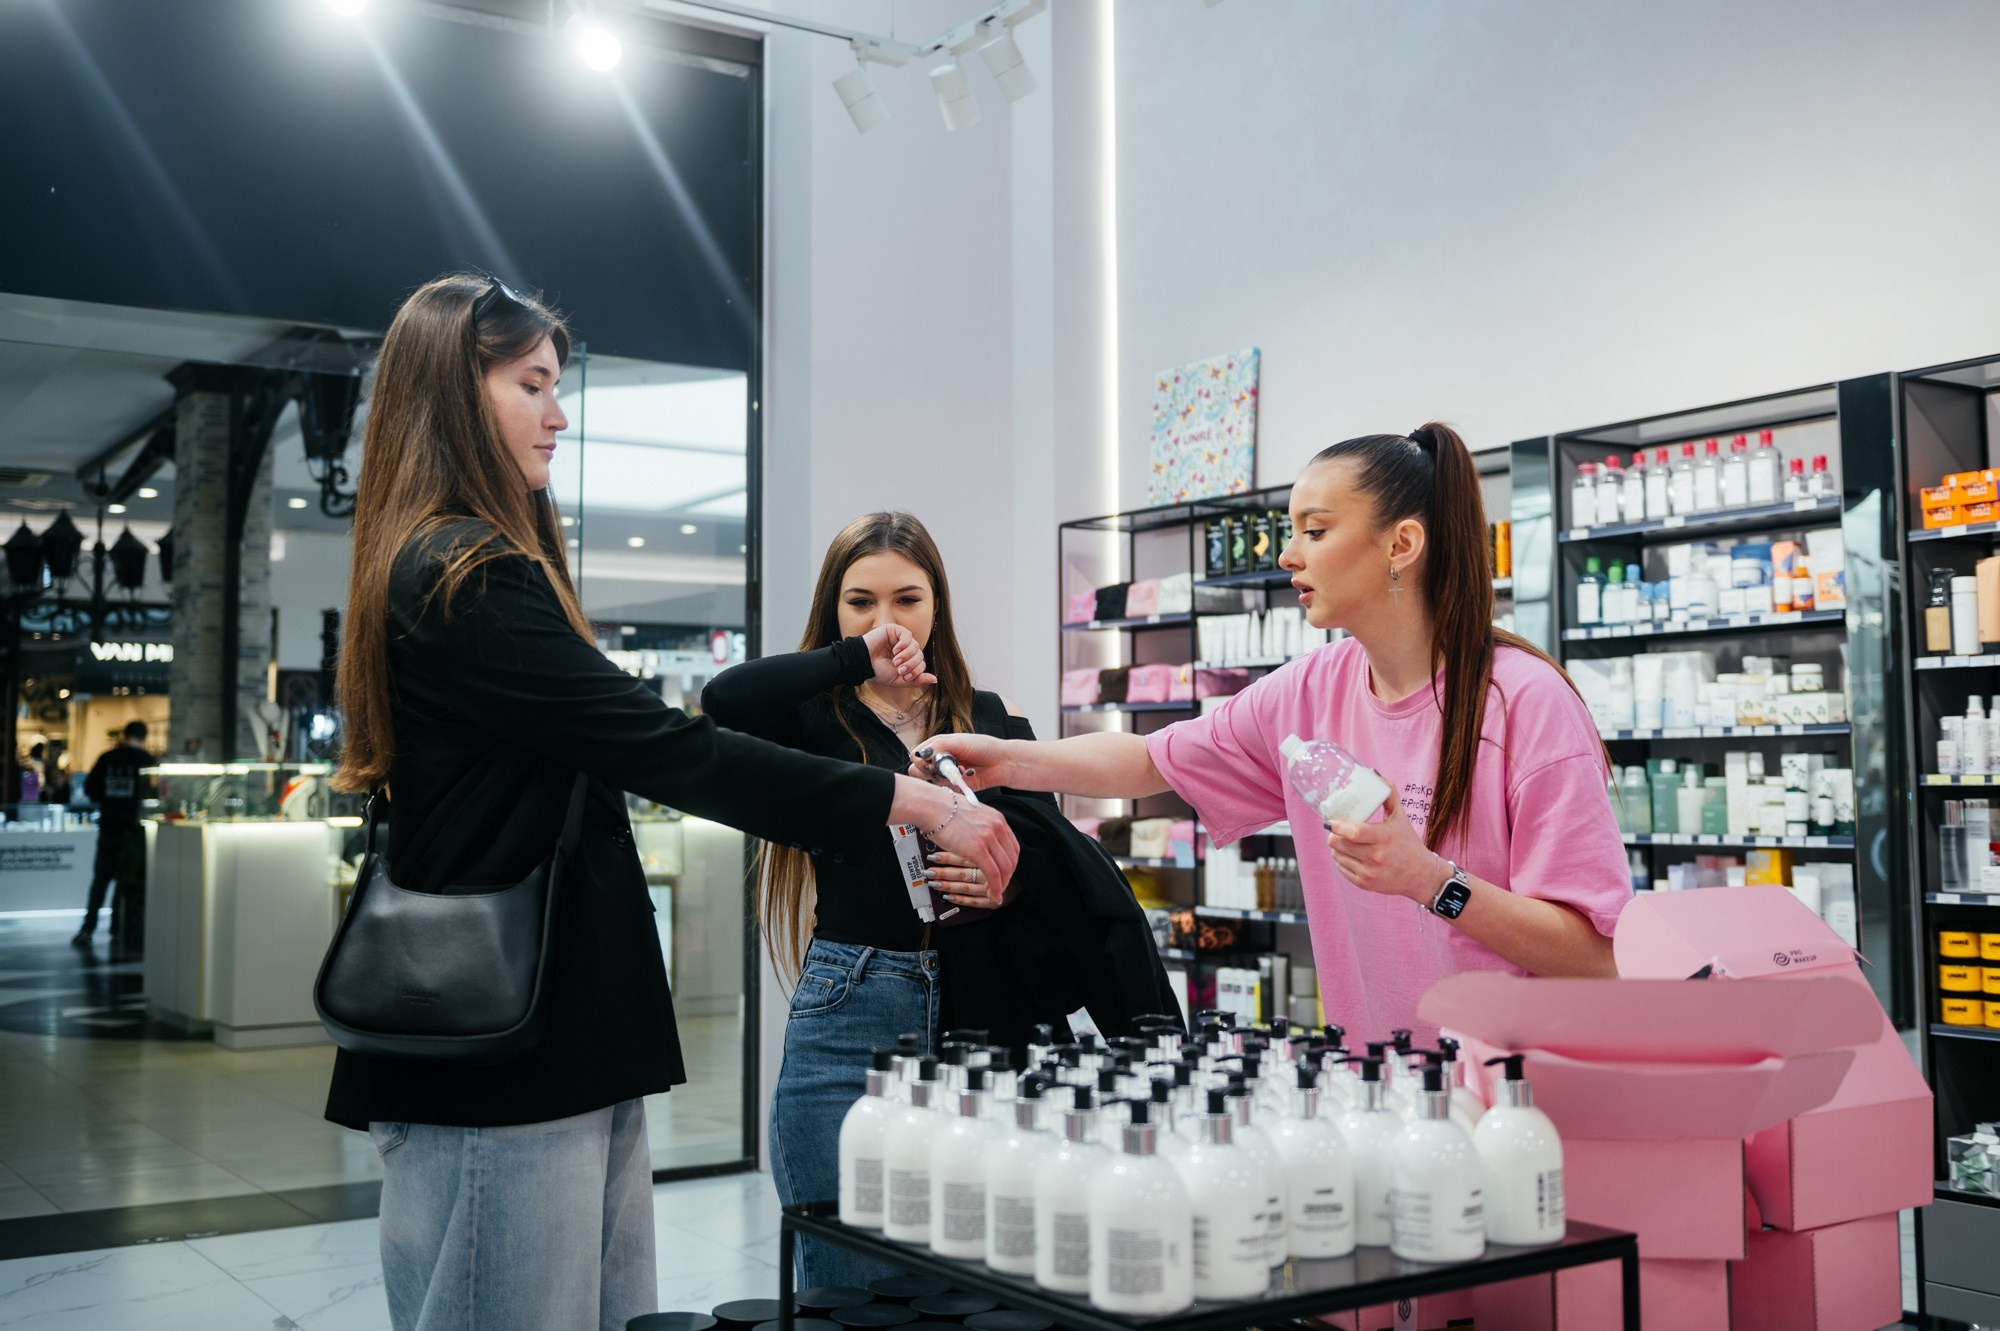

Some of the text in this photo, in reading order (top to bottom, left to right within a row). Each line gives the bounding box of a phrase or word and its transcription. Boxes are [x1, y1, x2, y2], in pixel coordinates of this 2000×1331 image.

[90, 642, 142, 661] VAN
[906, 861, 917, 880] ЦЕНТР
[1793, 955, 1817, 964] MAKEUP
